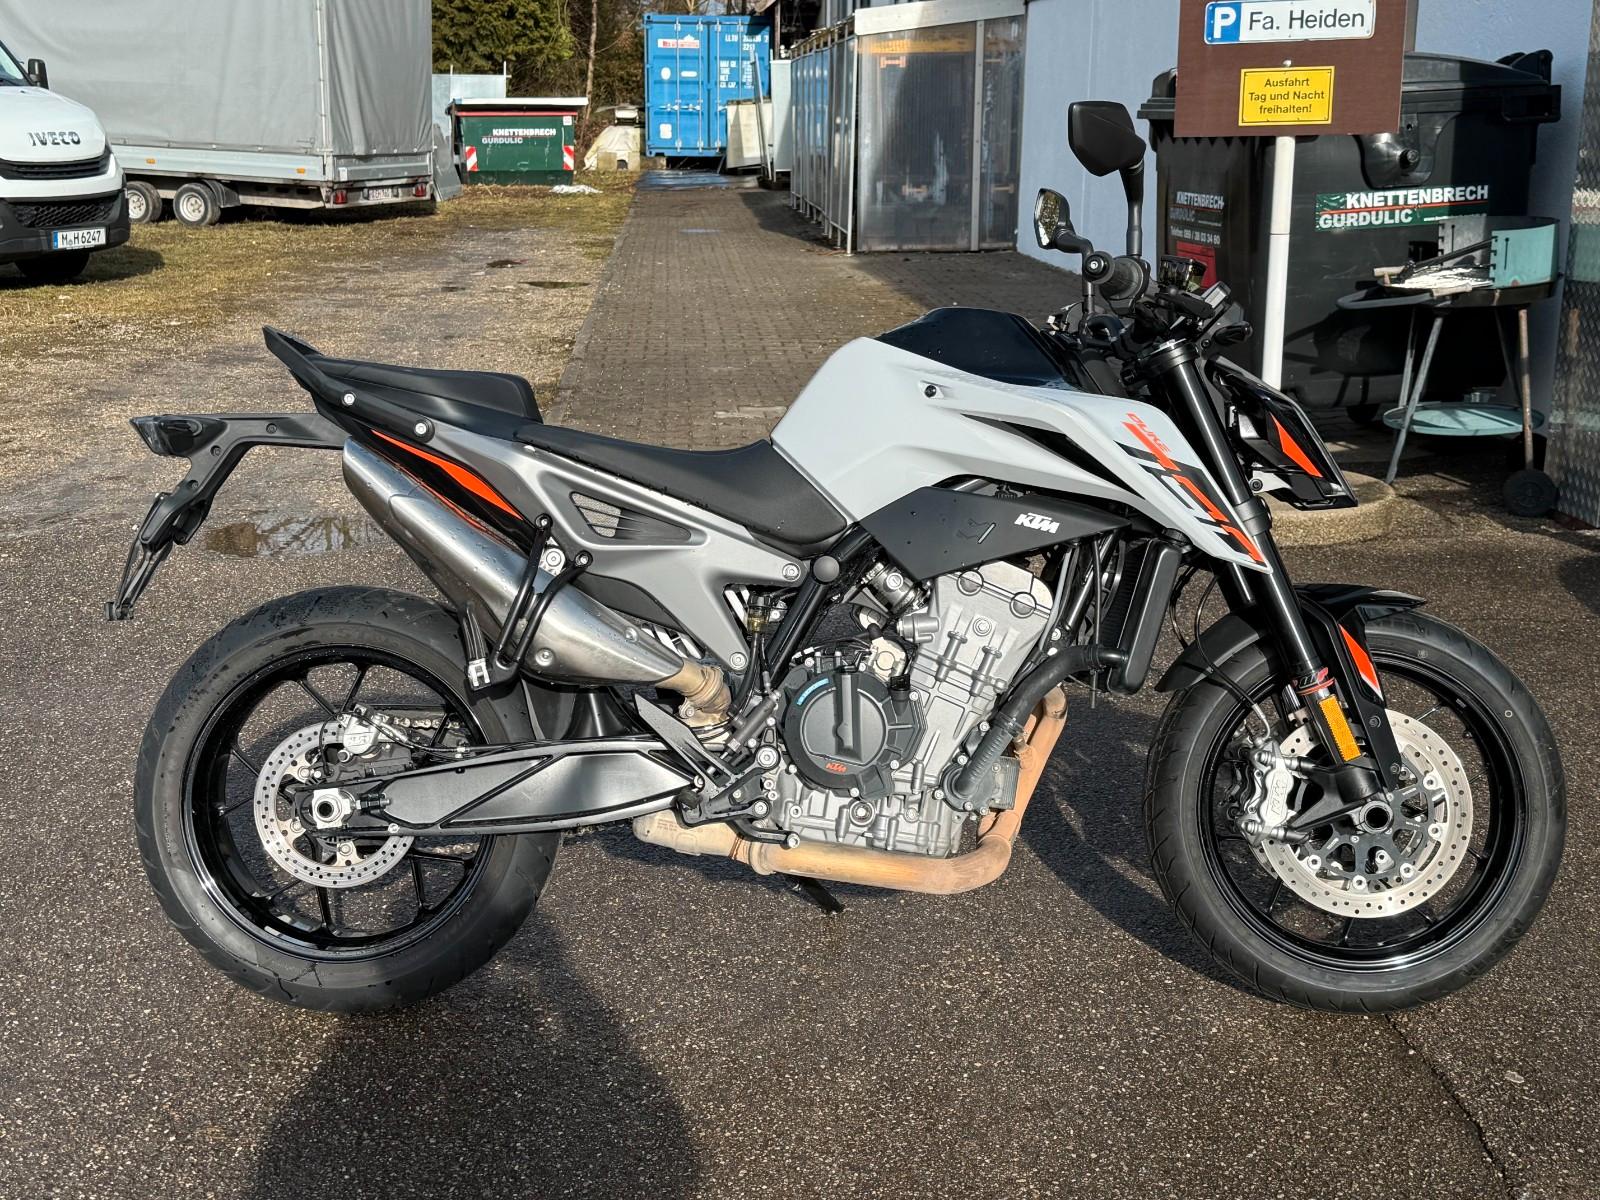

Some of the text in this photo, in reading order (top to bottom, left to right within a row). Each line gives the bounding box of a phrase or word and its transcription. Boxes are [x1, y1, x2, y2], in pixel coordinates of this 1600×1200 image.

[1213, 6, 1365, 39] P Fa. Heiden
[1264, 78, 1310, 88] Ausfahrt
[1248, 91, 1325, 103] Tag und Nacht
[1259, 104, 1312, 114] freihalten!
[27, 131, 82, 147] IVECO
[492, 128, 557, 137] KNETTENBRECH
[1176, 191, 1224, 210] KNETTENBRECH
[1346, 185, 1489, 209] KNETTENBRECH
[1319, 208, 1413, 229] GURDULIC
[1014, 512, 1060, 534] KTM
